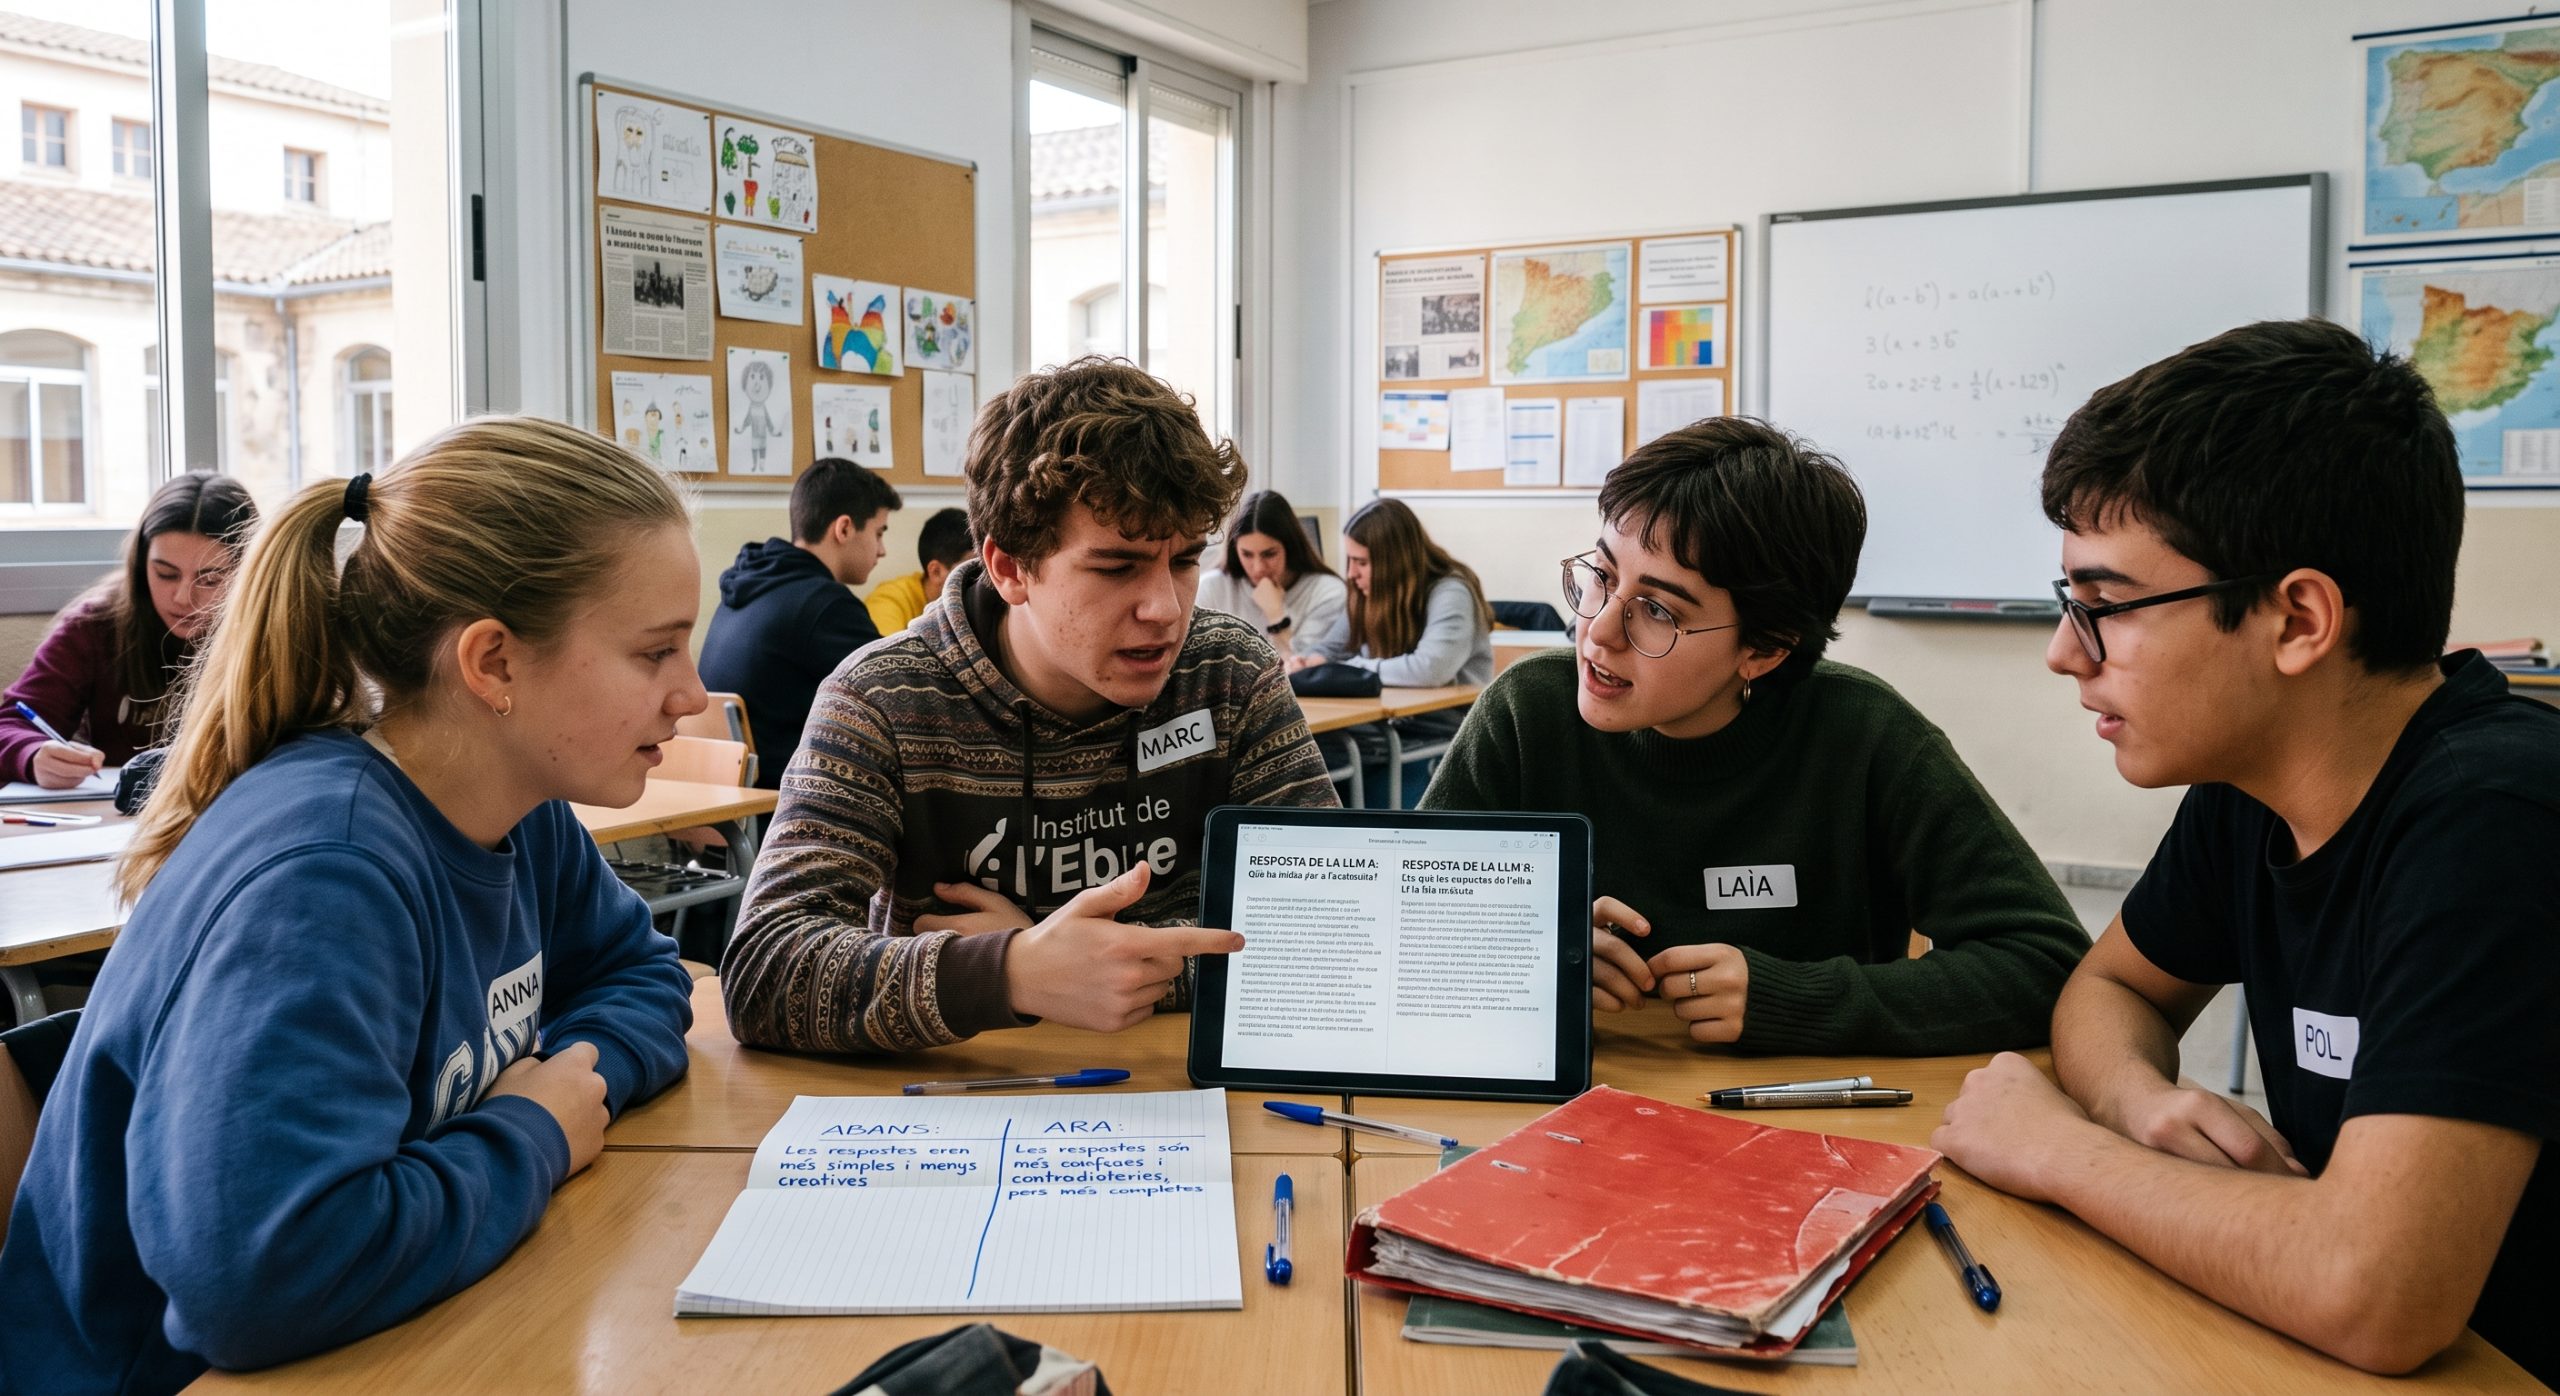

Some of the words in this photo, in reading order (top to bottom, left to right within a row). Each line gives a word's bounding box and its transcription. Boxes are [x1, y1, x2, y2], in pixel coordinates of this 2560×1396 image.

[1141, 722, 1204, 760] MARC
[1032, 804, 1126, 840] Institut
[1137, 795, 1171, 822] de
[1249, 855, 1306, 867] RESPOSTA
[1309, 858, 1324, 867] DE
[1326, 858, 1340, 868] LA
[1343, 858, 1365, 868] LLM
[1367, 859, 1379, 869] A:
[1402, 860, 1460, 871] RESPOSTA
[1463, 861, 1478, 872] DE
[1481, 862, 1495, 872] LA
[492, 972, 539, 1019] ANNA
[2306, 1024, 2343, 1061] POL
[821, 1124, 940, 1136] ABANS:
[1044, 1121, 1124, 1134] ARA:
[785, 1145, 817, 1155] Les
[828, 1145, 917, 1158] respostes
[1015, 1143, 1047, 1154] Les
[1158, 1142, 1190, 1152] són
[780, 1157, 816, 1170] més
[827, 1160, 895, 1175] simples
[904, 1160, 910, 1171] i
[920, 1161, 977, 1175] menys
[1014, 1157, 1049, 1169] més
[1158, 1157, 1163, 1166] i
[778, 1173, 868, 1187] creatives
[1060, 1185, 1098, 1195] més
